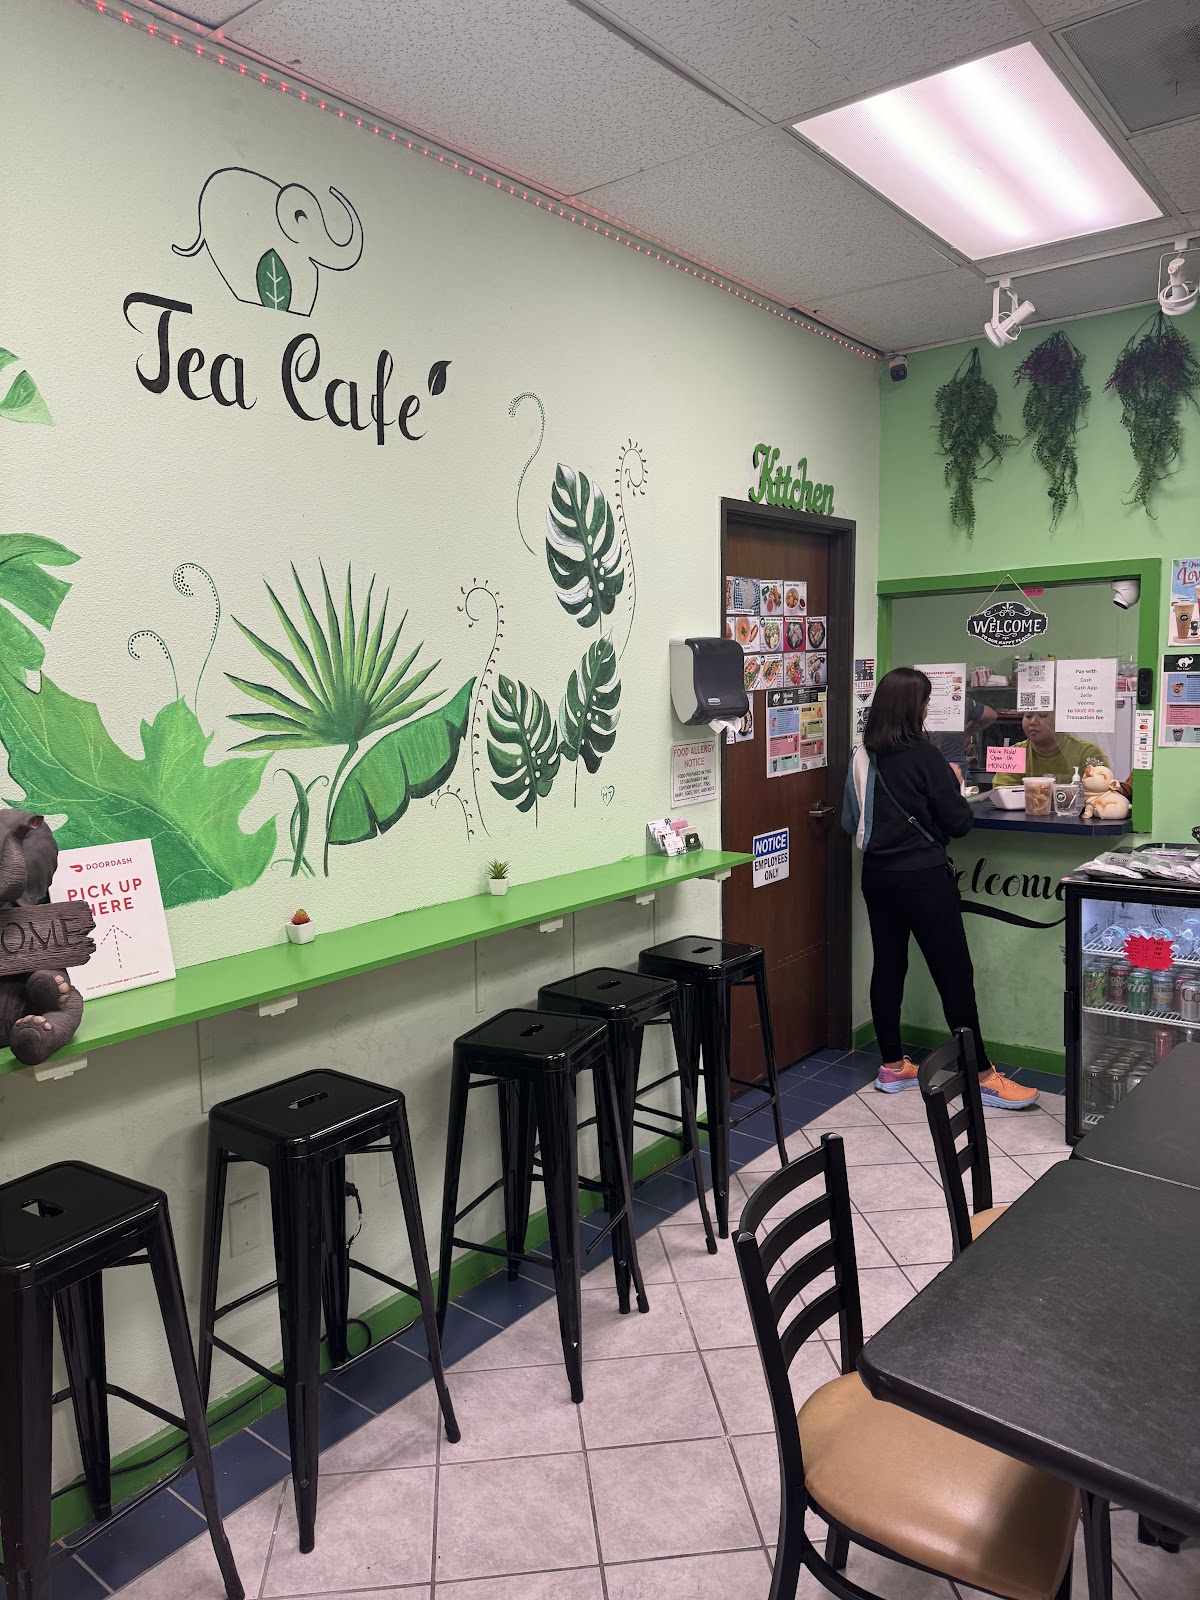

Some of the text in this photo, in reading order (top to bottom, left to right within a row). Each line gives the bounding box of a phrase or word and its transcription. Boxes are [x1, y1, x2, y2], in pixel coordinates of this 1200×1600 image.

[123, 291, 257, 410] Tea
[748, 443, 835, 516] Kitchen
[973, 617, 1042, 634] WELCOME
[1016, 633, 1032, 643] PLACE
[674, 744, 714, 758] FOOD ALLERGY
[684, 757, 704, 768] NOTICE
[756, 834, 787, 855] NOTICE
[86, 858, 132, 870] DOORDASH
[754, 853, 788, 872] EMPLOYEES
[764, 868, 779, 880] ONLY
[950, 857, 1066, 901] elcome
[67, 878, 142, 902] PICK UP
[1127, 982, 1149, 993] rite
